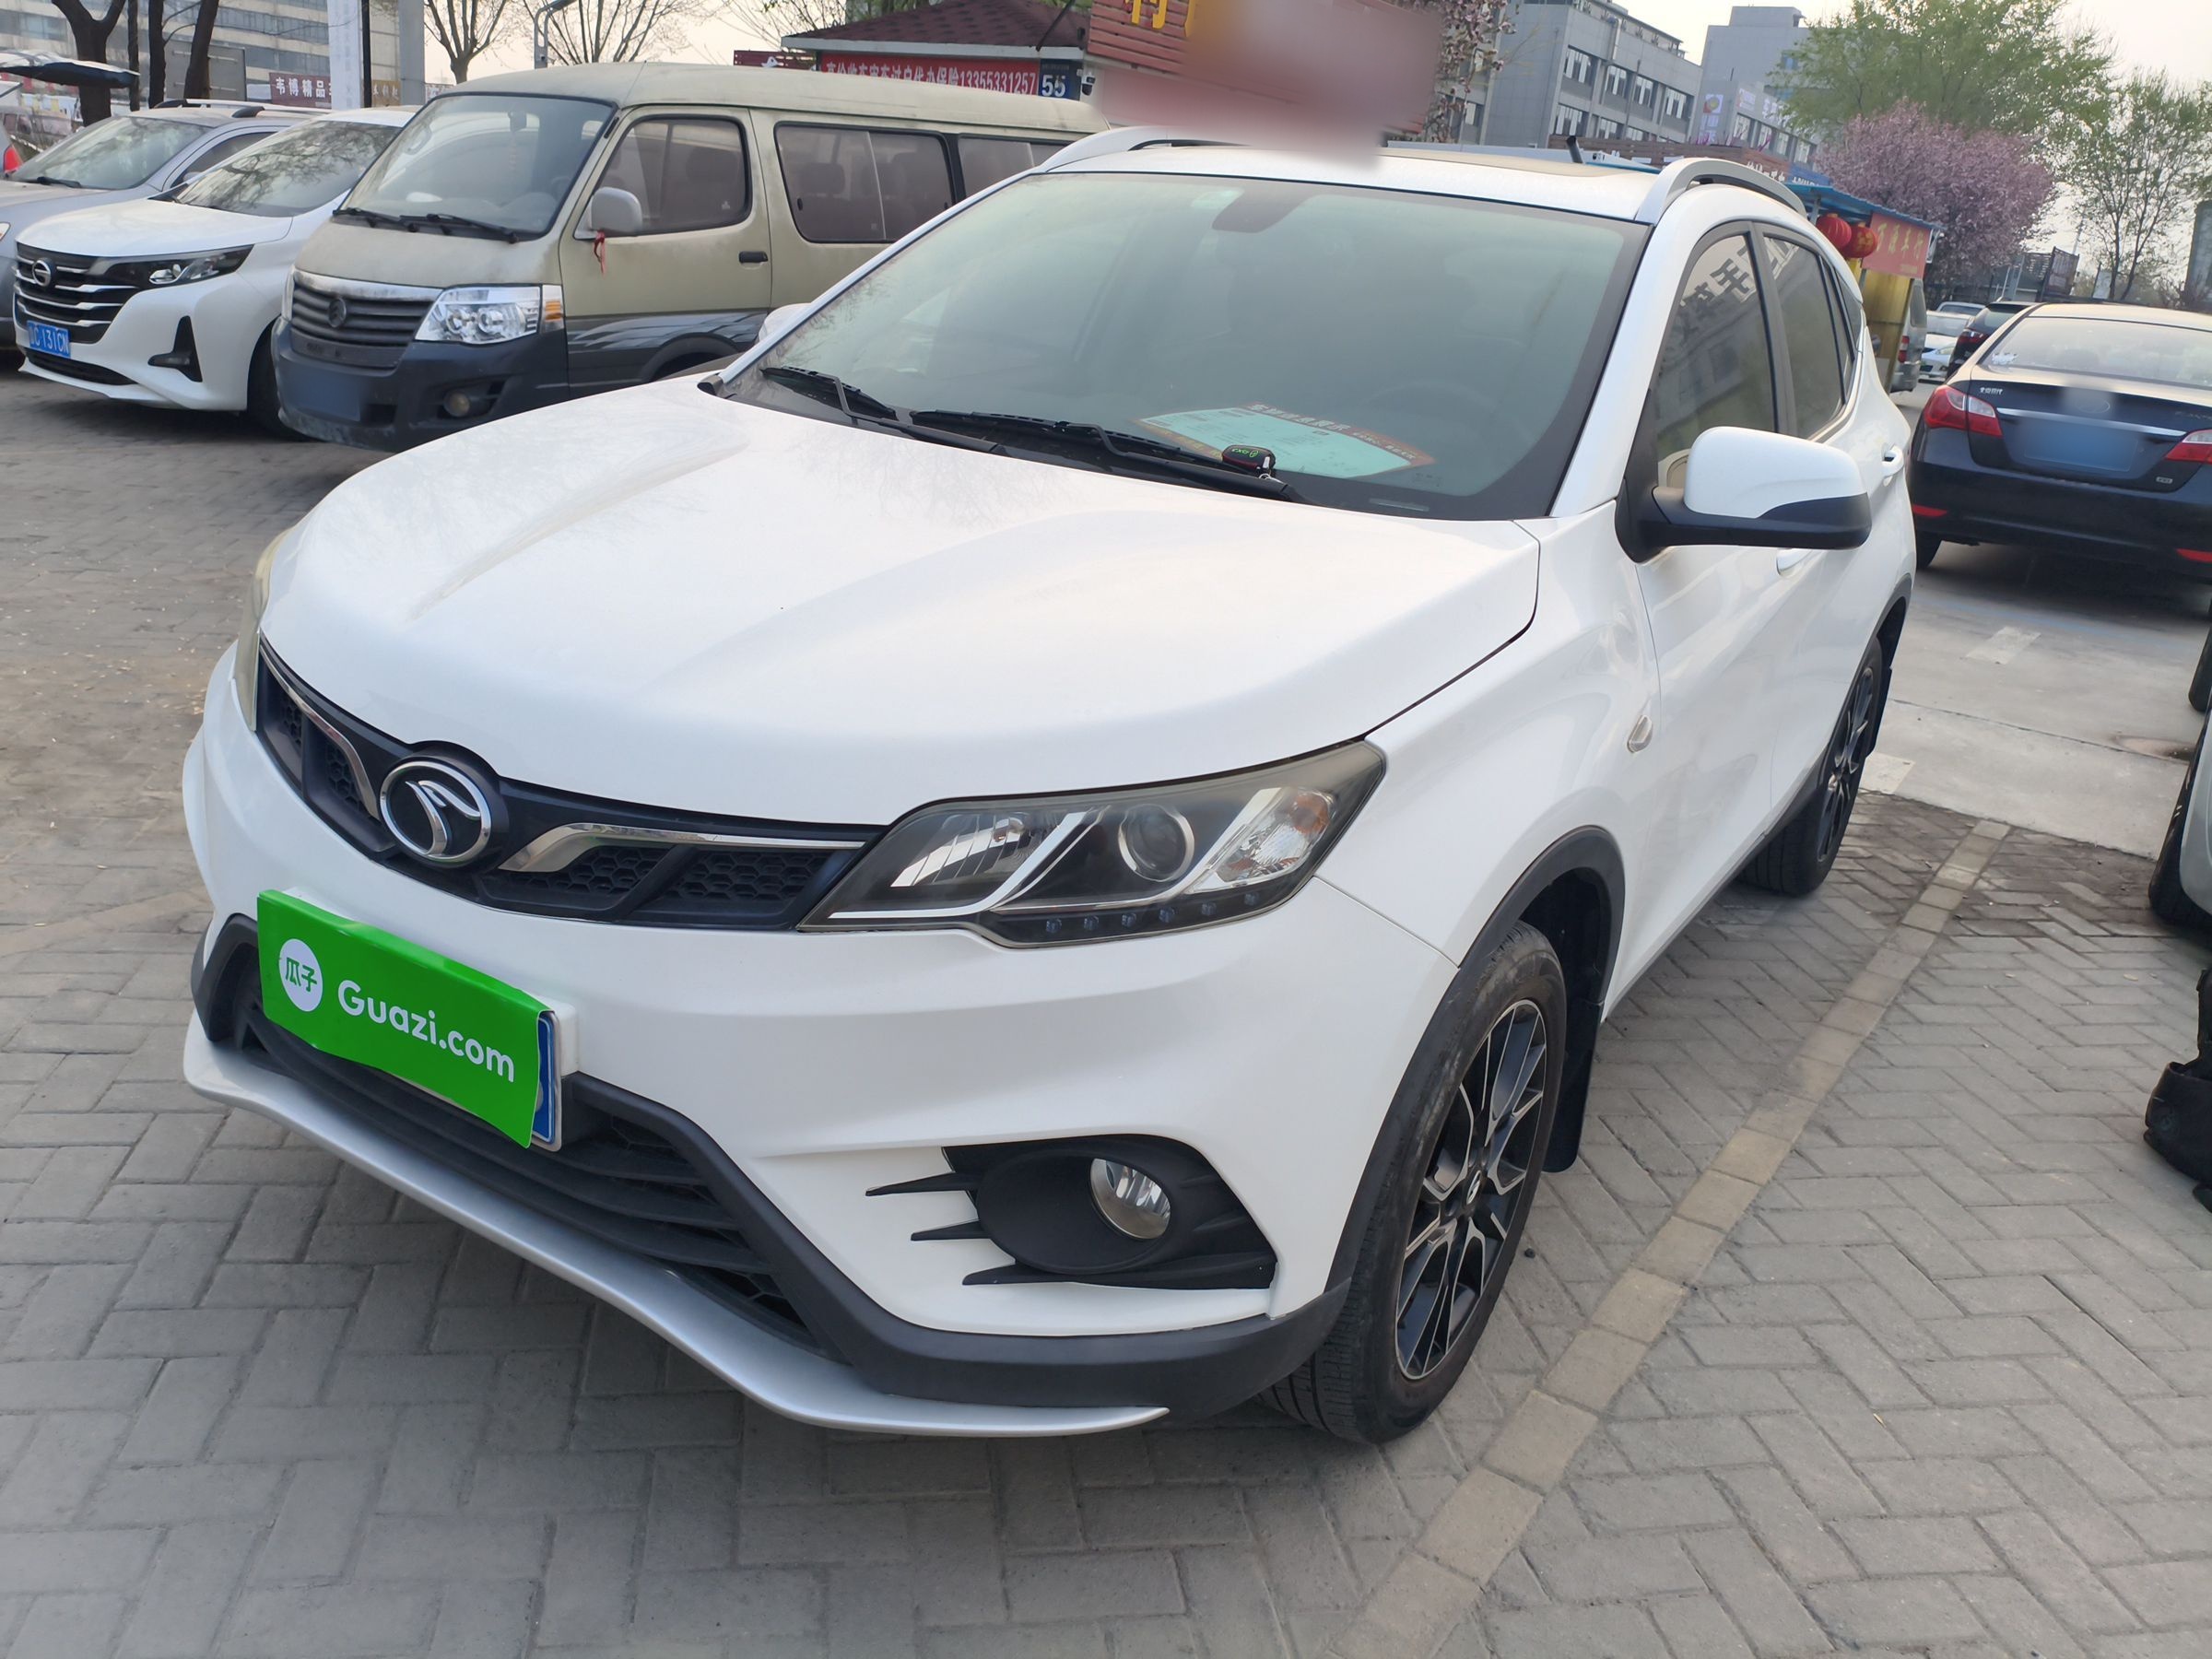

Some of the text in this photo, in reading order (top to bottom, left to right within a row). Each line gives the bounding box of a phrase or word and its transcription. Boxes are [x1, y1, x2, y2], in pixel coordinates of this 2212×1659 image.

[276, 76, 331, 99] 韦博精品
[1041, 75, 1066, 97] 55
[286, 957, 317, 992] 瓜子
[338, 980, 514, 1083] Guazi.com
